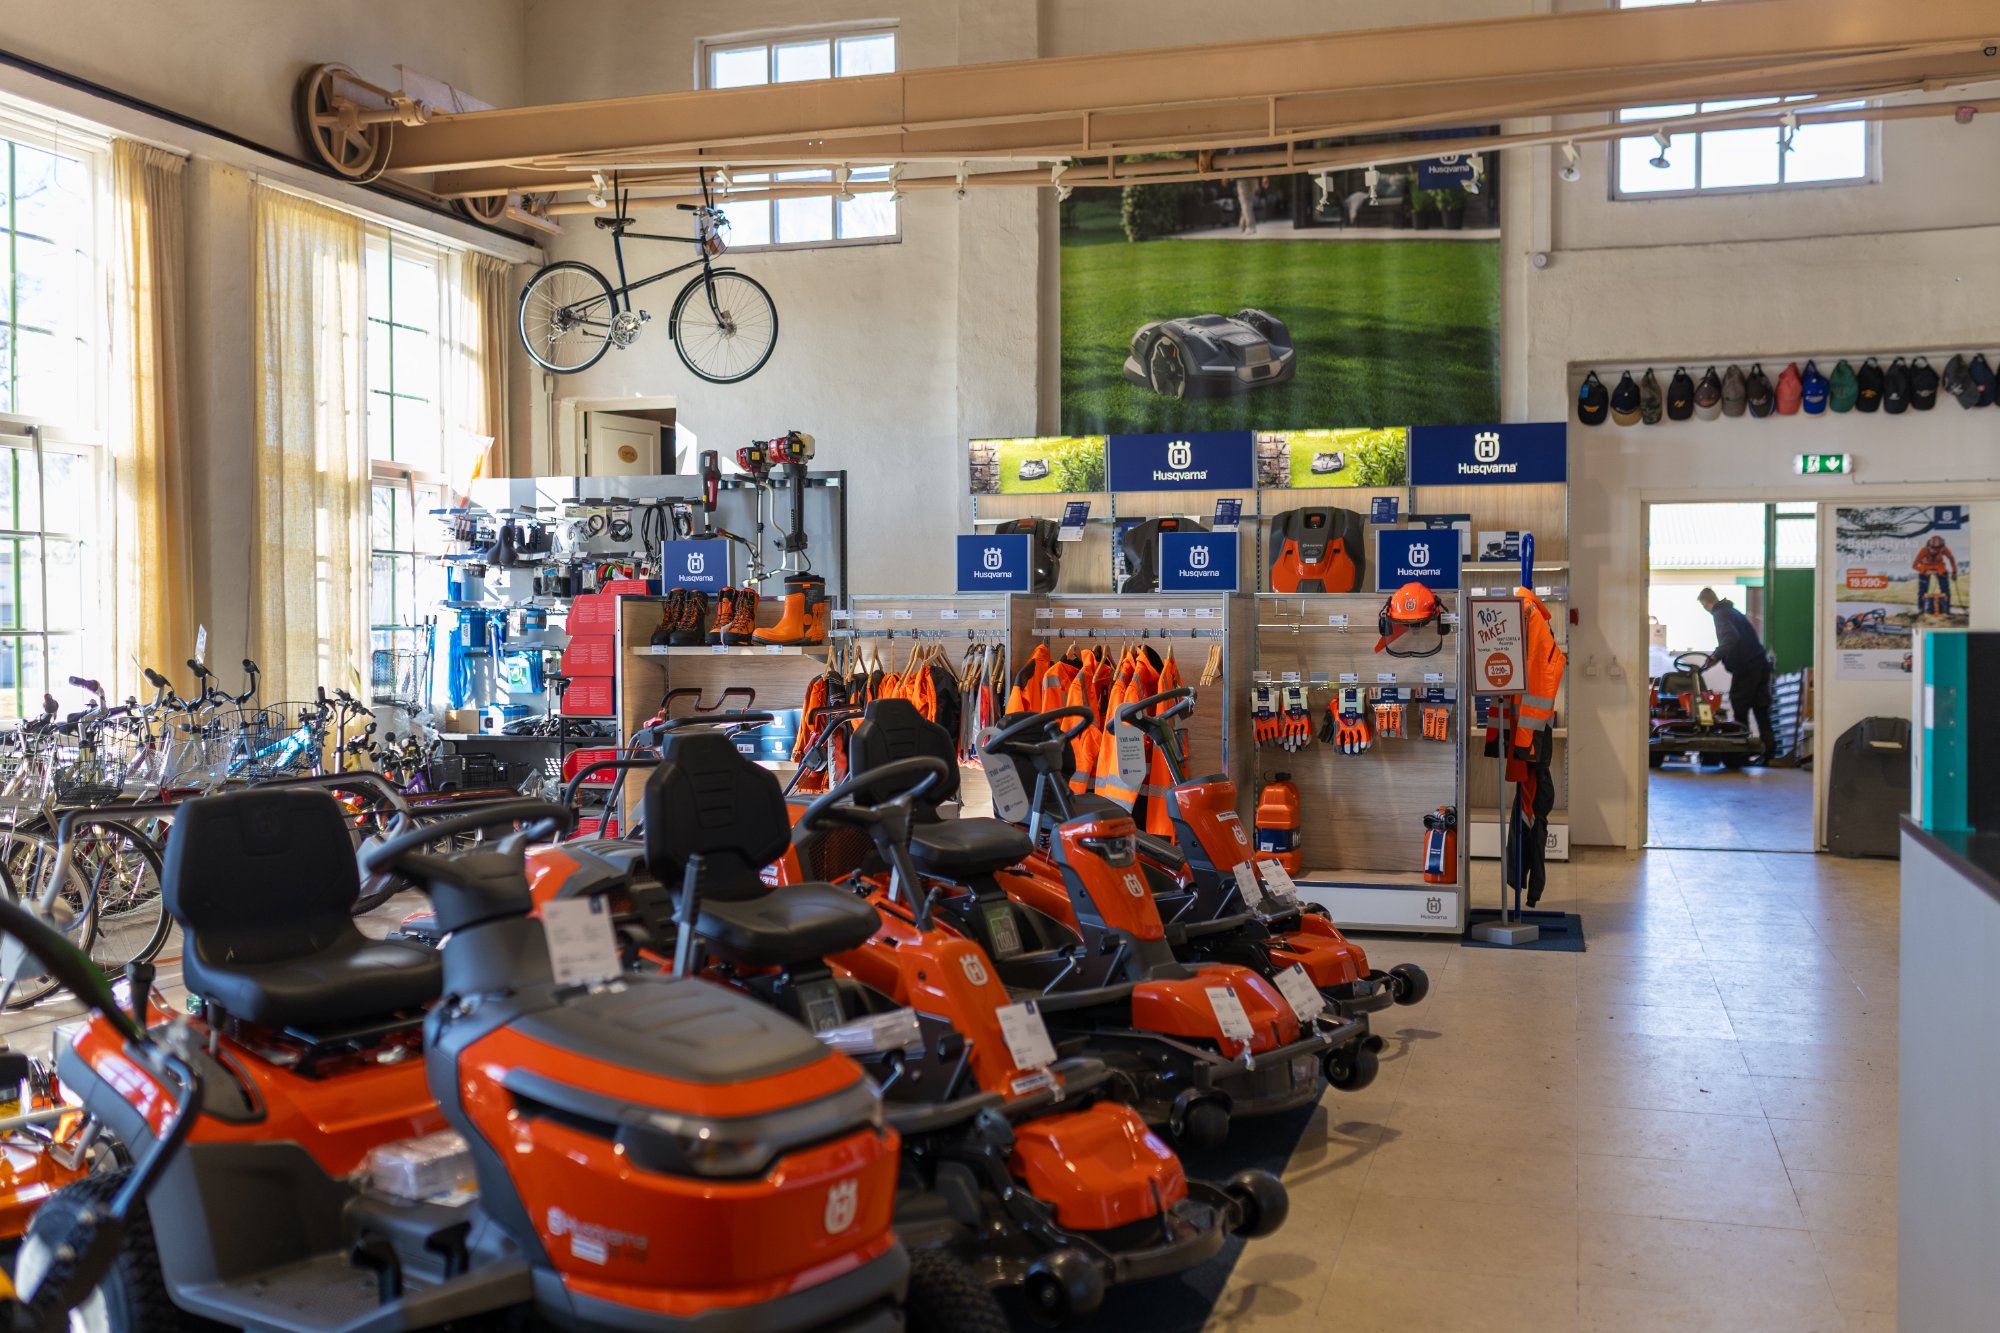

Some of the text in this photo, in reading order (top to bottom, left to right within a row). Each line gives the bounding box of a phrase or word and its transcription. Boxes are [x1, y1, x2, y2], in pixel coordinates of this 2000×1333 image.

[1428, 165, 1470, 175] Husqvarna
[1458, 462, 1516, 475] Husqvarna
[1153, 470, 1206, 481] Husqvarna
[973, 570, 1012, 579] Husqvarna
[1179, 569, 1219, 578] Husqvarna
[1397, 567, 1440, 577] Husqvarna
[678, 574, 713, 582] Husqvarna
[1478, 619, 1507, 643] PAKET
